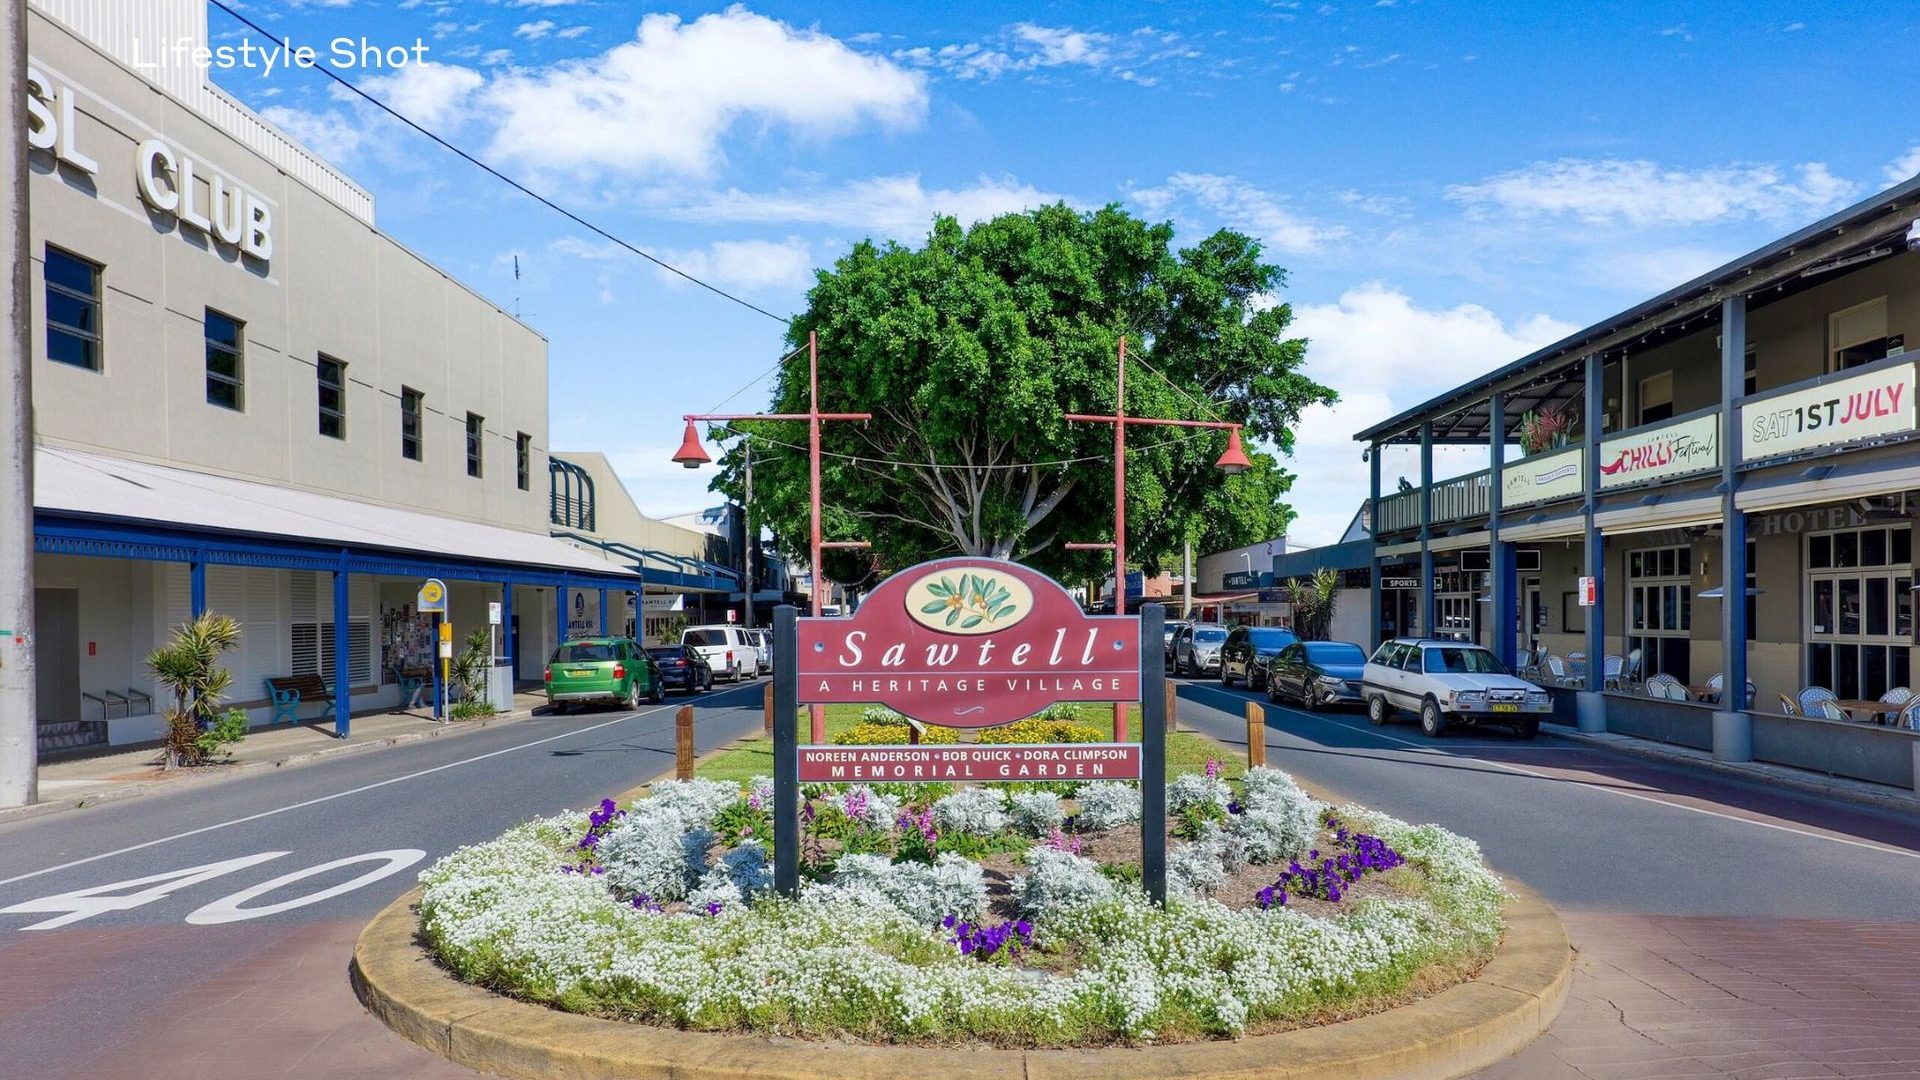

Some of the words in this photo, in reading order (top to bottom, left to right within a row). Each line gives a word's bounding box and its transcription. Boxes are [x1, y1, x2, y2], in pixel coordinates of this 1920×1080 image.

[136, 139, 273, 261] CLUB
[1752, 409, 1793, 443] SAT
[1794, 398, 1840, 433] 1ST
[1839, 382, 1905, 424] JULY
[1763, 506, 1867, 535] HOTEL
[1389, 579, 1418, 587] SPORTS
[839, 627, 1098, 667] Sawtell
[819, 680, 831, 692] A
[852, 679, 985, 692] HERITAGE
[1007, 678, 1120, 691] VILLAGE
[806, 752, 857, 762] NOREEN
[861, 751, 930, 762] ANDERSON
[942, 751, 968, 761] BOB
[972, 750, 1011, 762] QUICK
[1023, 750, 1060, 761] DORA
[1063, 749, 1128, 760] CLIMPSON
[832, 765, 973, 777] MEMORIAL
[1000, 764, 1104, 776] GARDEN
[0, 848, 427, 931] 40
